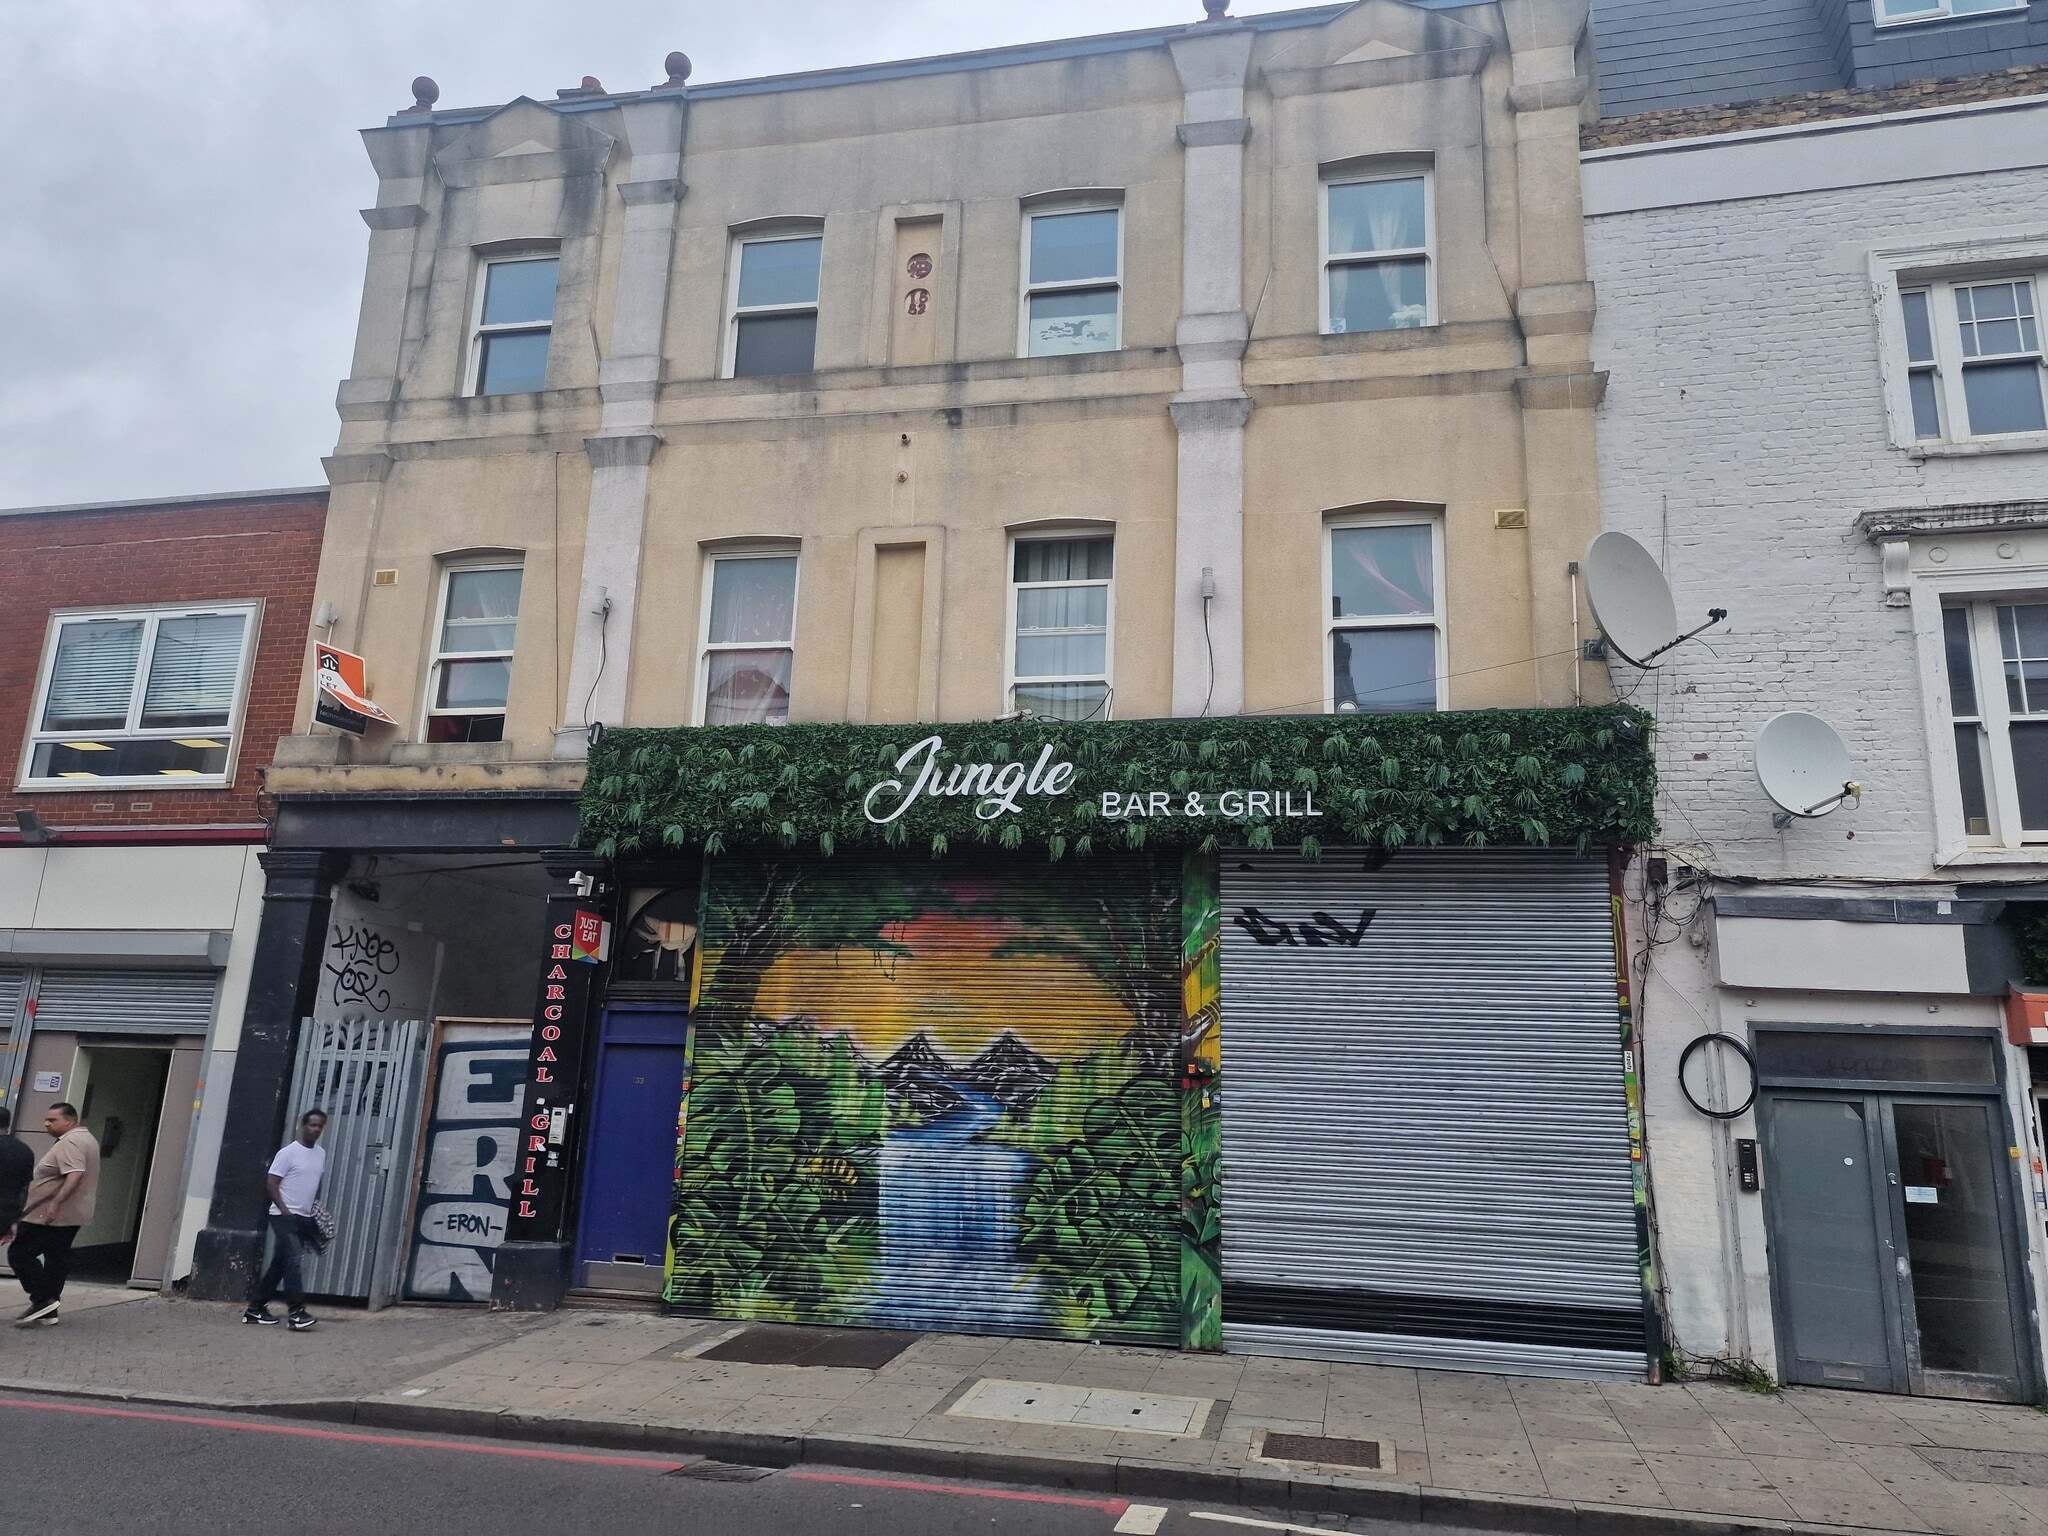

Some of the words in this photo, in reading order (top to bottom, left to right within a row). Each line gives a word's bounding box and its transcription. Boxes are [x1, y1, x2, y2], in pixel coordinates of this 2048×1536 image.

[320, 673, 332, 681] TO
[864, 735, 1077, 824] Jungle
[1102, 791, 1171, 817] BAR
[1184, 791, 1206, 817] &
[1219, 790, 1324, 817] GRILL
[579, 916, 599, 931] JUST
[582, 930, 598, 943] EAT
[535, 923, 572, 1083] CHARCOAL
[518, 1113, 551, 1218] GRILL
